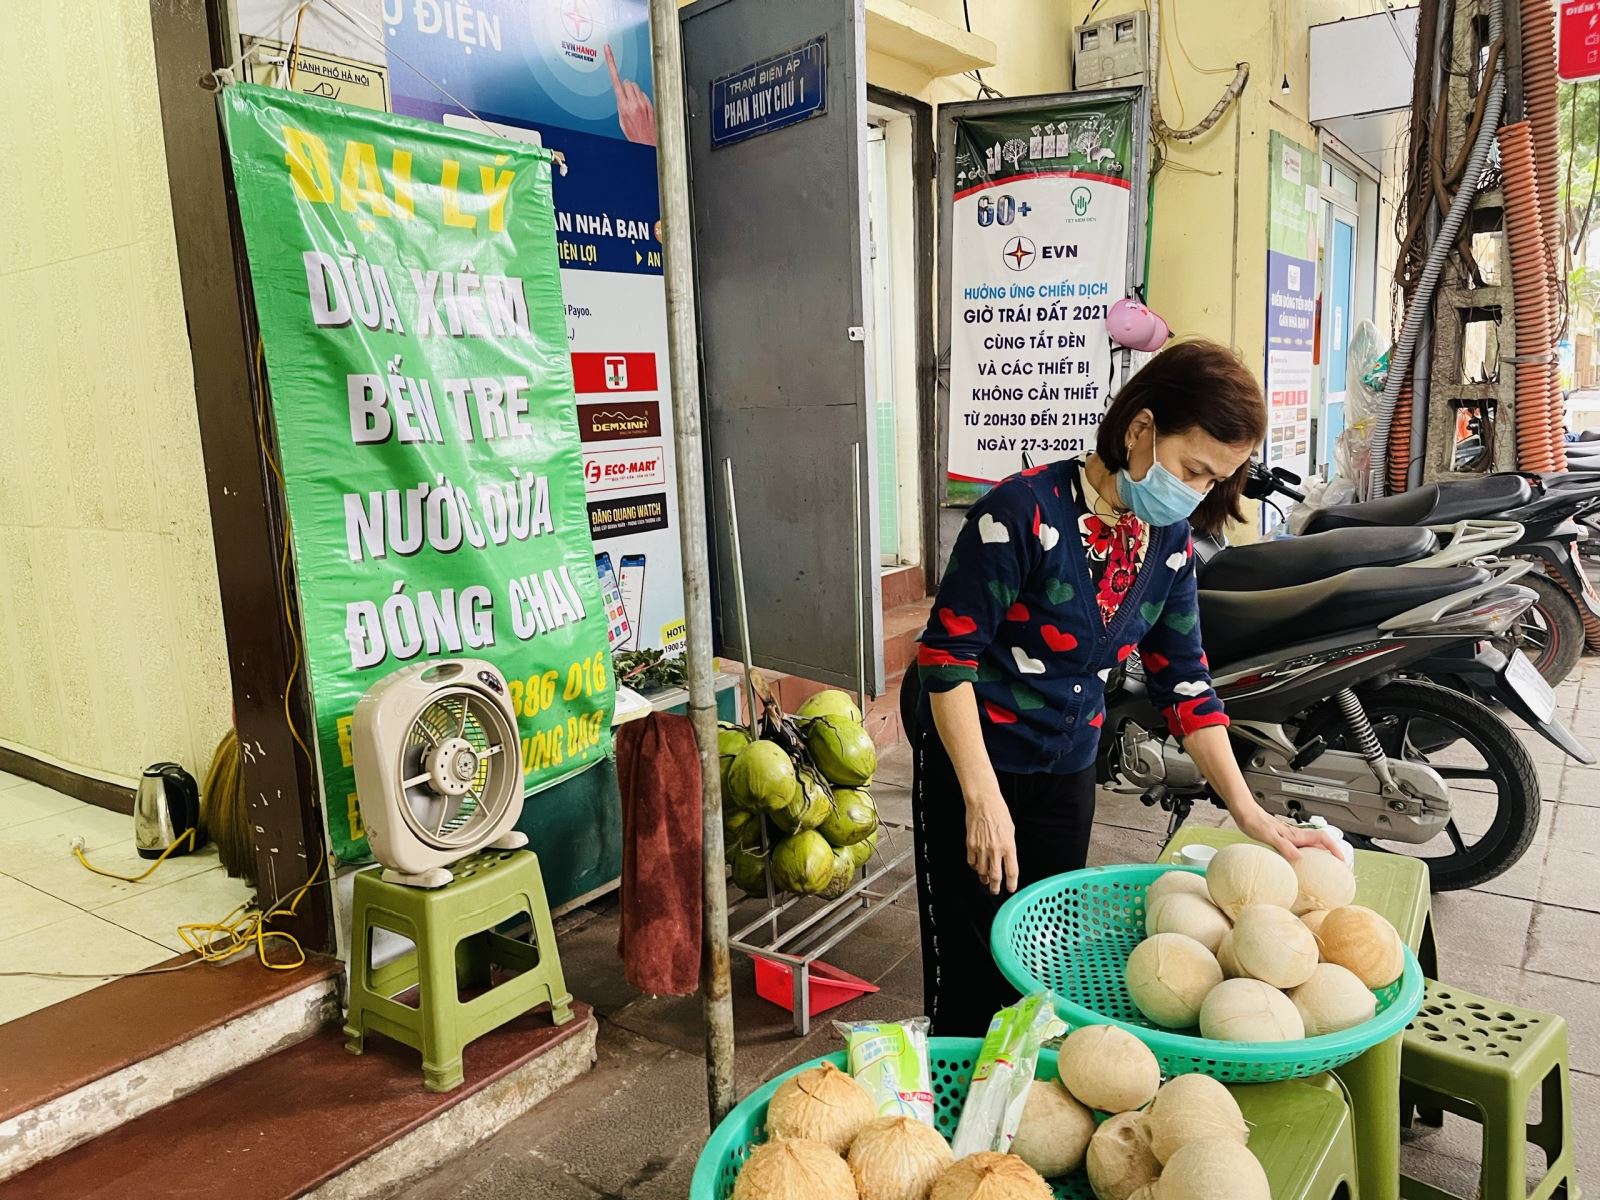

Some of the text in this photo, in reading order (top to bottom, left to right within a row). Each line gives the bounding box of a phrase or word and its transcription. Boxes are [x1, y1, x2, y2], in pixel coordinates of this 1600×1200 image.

[413, 0, 501, 54] ĐIỆN
[297, 60, 320, 72] HÀNH
[323, 66, 339, 77] PHỐ
[341, 70, 353, 80] HÀ
[354, 74, 369, 86] NỘI
[724, 76, 804, 129] PHAN HUY CHÚ 1
[283, 126, 516, 232] ĐẠI LÝ
[977, 195, 1032, 227] 60+
[575, 213, 613, 237] NHÀ
[616, 218, 650, 245] BẠN
[556, 240, 661, 267] IỆN LỢI AN
[1042, 245, 1078, 259] EVN
[303, 241, 532, 339] DỪA XIÊM
[964, 279, 1108, 300] HƯỞNG ỨNG CHIẾN DỊCH
[568, 304, 592, 318] Payoo.
[964, 300, 1108, 323] GIỜ TRÁI ĐẤT 2021
[984, 330, 1086, 350] CÙNG TẮT ĐÈN
[978, 356, 1090, 377] VÀ CÁC THIẾT BỊ
[347, 354, 533, 446] BẾN TRE
[972, 382, 1099, 401] KHÔNG CẦN THIẾT
[964, 409, 1104, 426] TỪ 20H30 ĐẾN 21H30
[977, 436, 1085, 451] NGÀY 27-3-2021
[605, 460, 656, 475] ECO-MART
[343, 466, 554, 562] NƯỚC DỪA
[613, 506, 637, 522] QUANG
[637, 502, 661, 518] WATCH
[344, 565, 587, 671] ĐÓNG CHAI
[664, 643, 680, 653] 1900
[563, 651, 607, 700] 016
[522, 724, 563, 776] ƯNG
